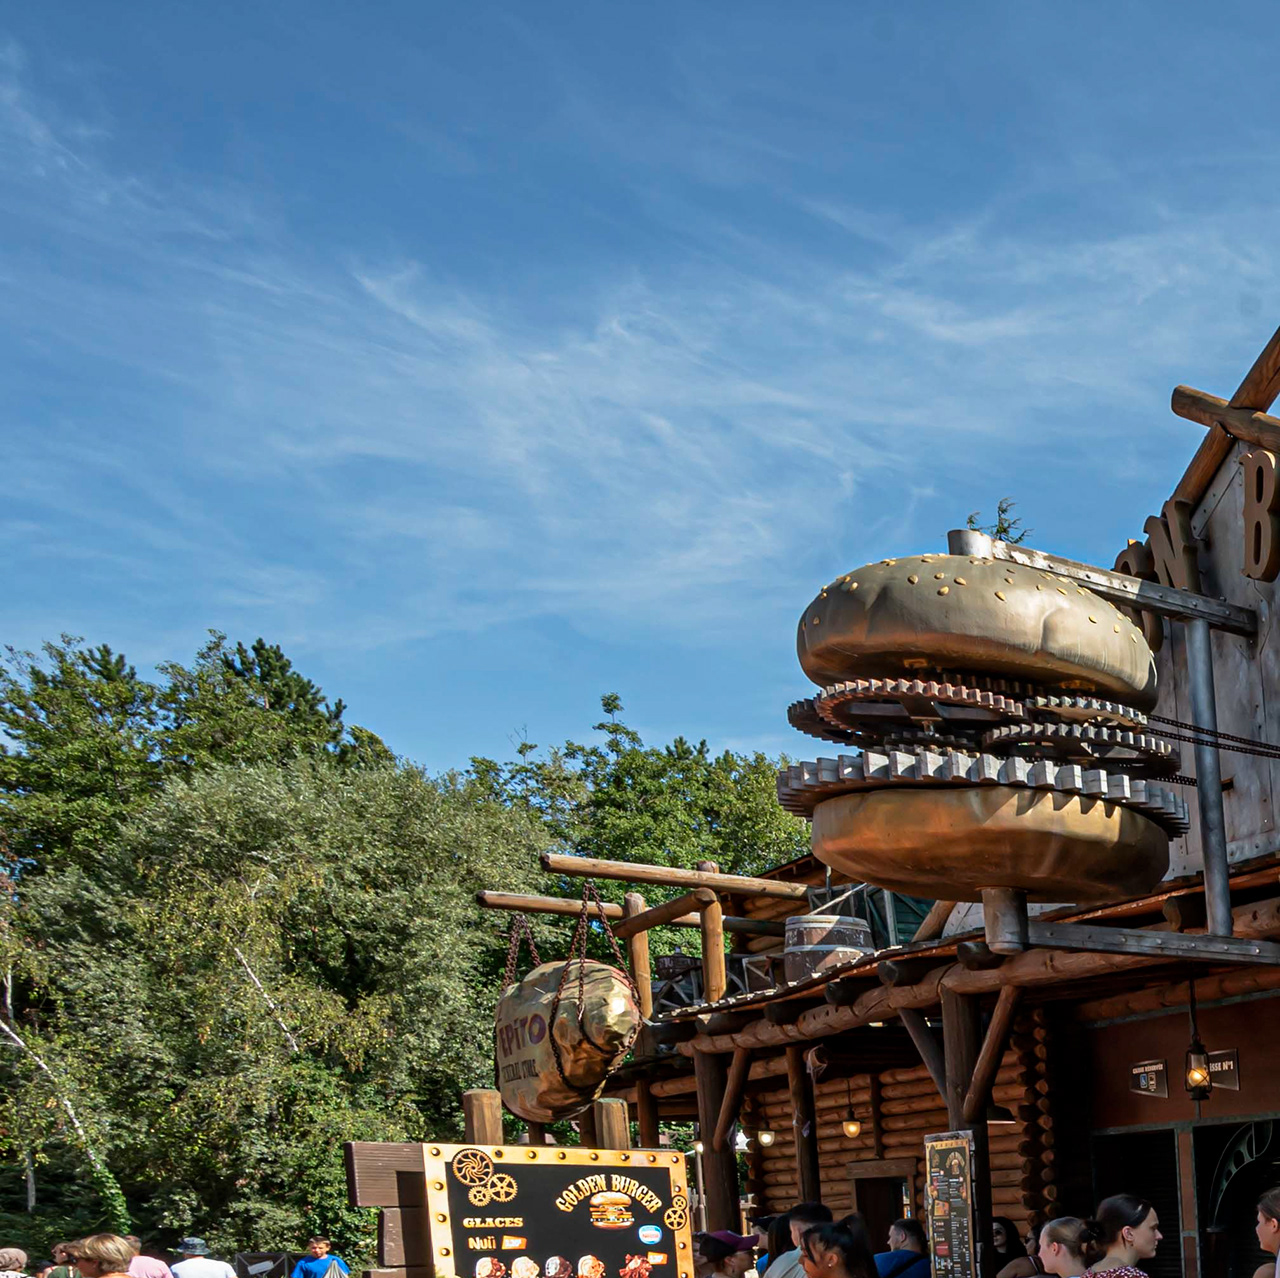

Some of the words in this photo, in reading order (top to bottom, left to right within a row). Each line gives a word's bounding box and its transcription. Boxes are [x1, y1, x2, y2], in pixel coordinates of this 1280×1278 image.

[555, 1174, 607, 1213] GOLDEN
[610, 1174, 663, 1214] BURGER
[463, 1217, 524, 1228] GLACES
